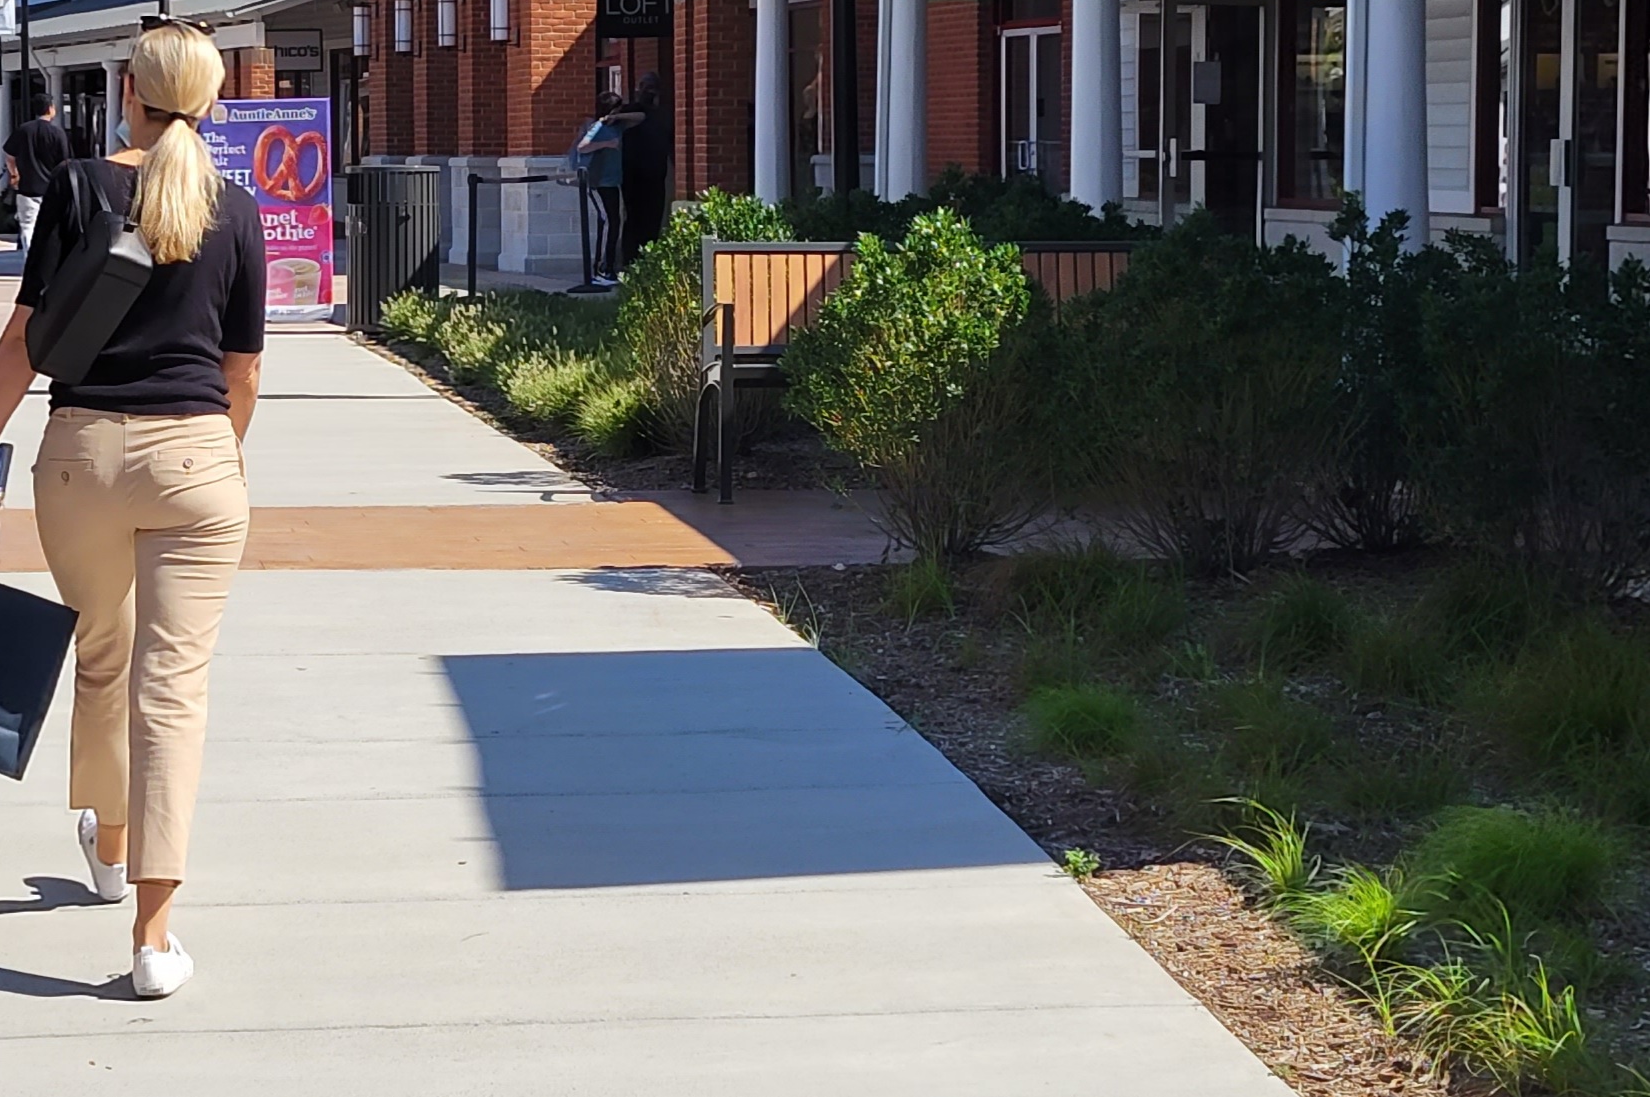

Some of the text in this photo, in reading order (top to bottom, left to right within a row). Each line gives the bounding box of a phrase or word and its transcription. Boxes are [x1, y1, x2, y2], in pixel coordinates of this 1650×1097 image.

[622, 16, 659, 25] OUTLET
[274, 45, 320, 58] hico's
[203, 131, 226, 143] The
[209, 141, 246, 155] erfect
